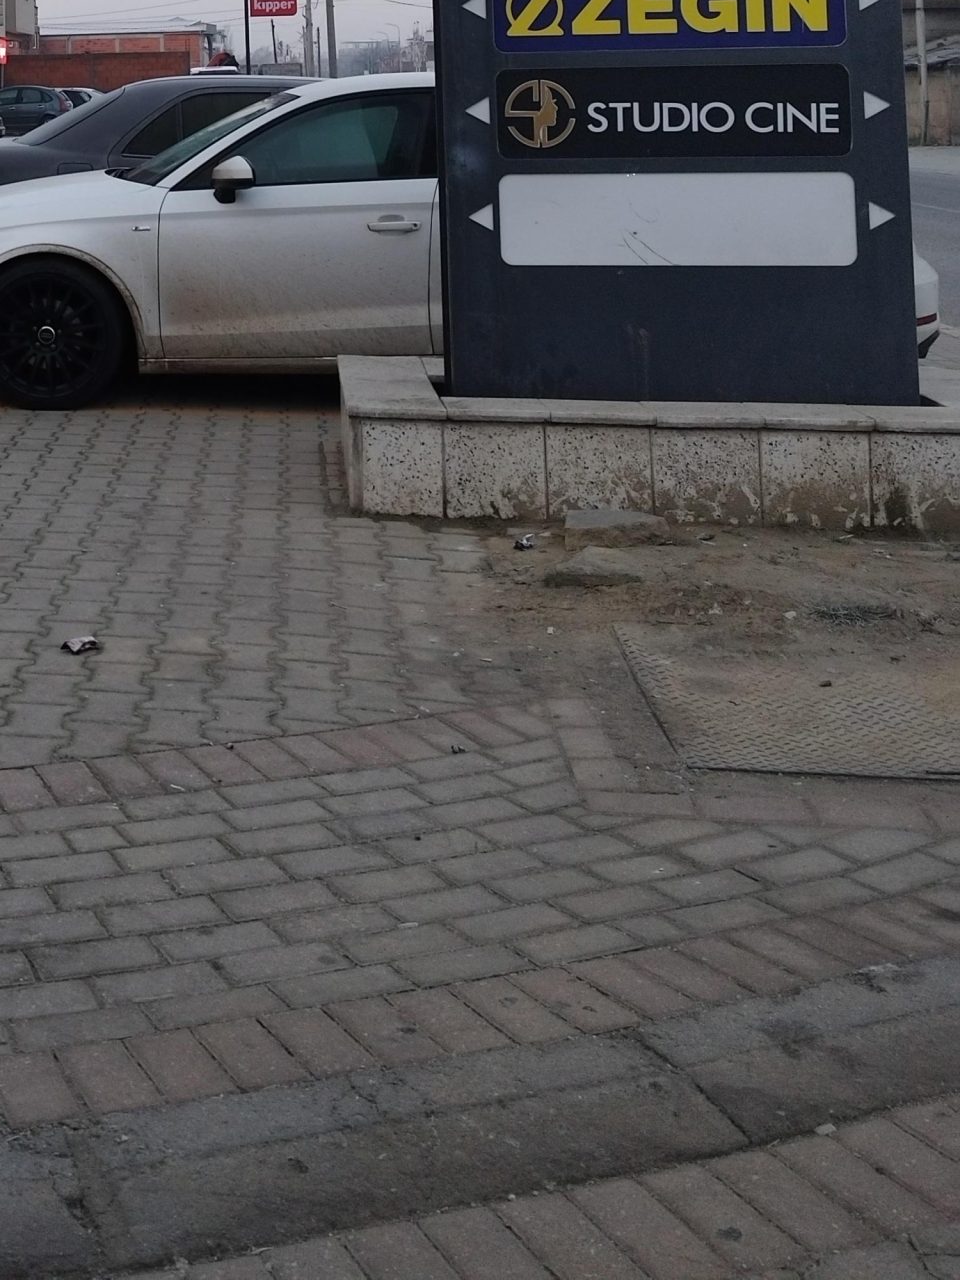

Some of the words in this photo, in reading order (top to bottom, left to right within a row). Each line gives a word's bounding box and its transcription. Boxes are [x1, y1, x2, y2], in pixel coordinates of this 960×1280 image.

[253, 0, 294, 12] kipper
[587, 102, 735, 132] STUDIO
[744, 102, 840, 133] CINE
